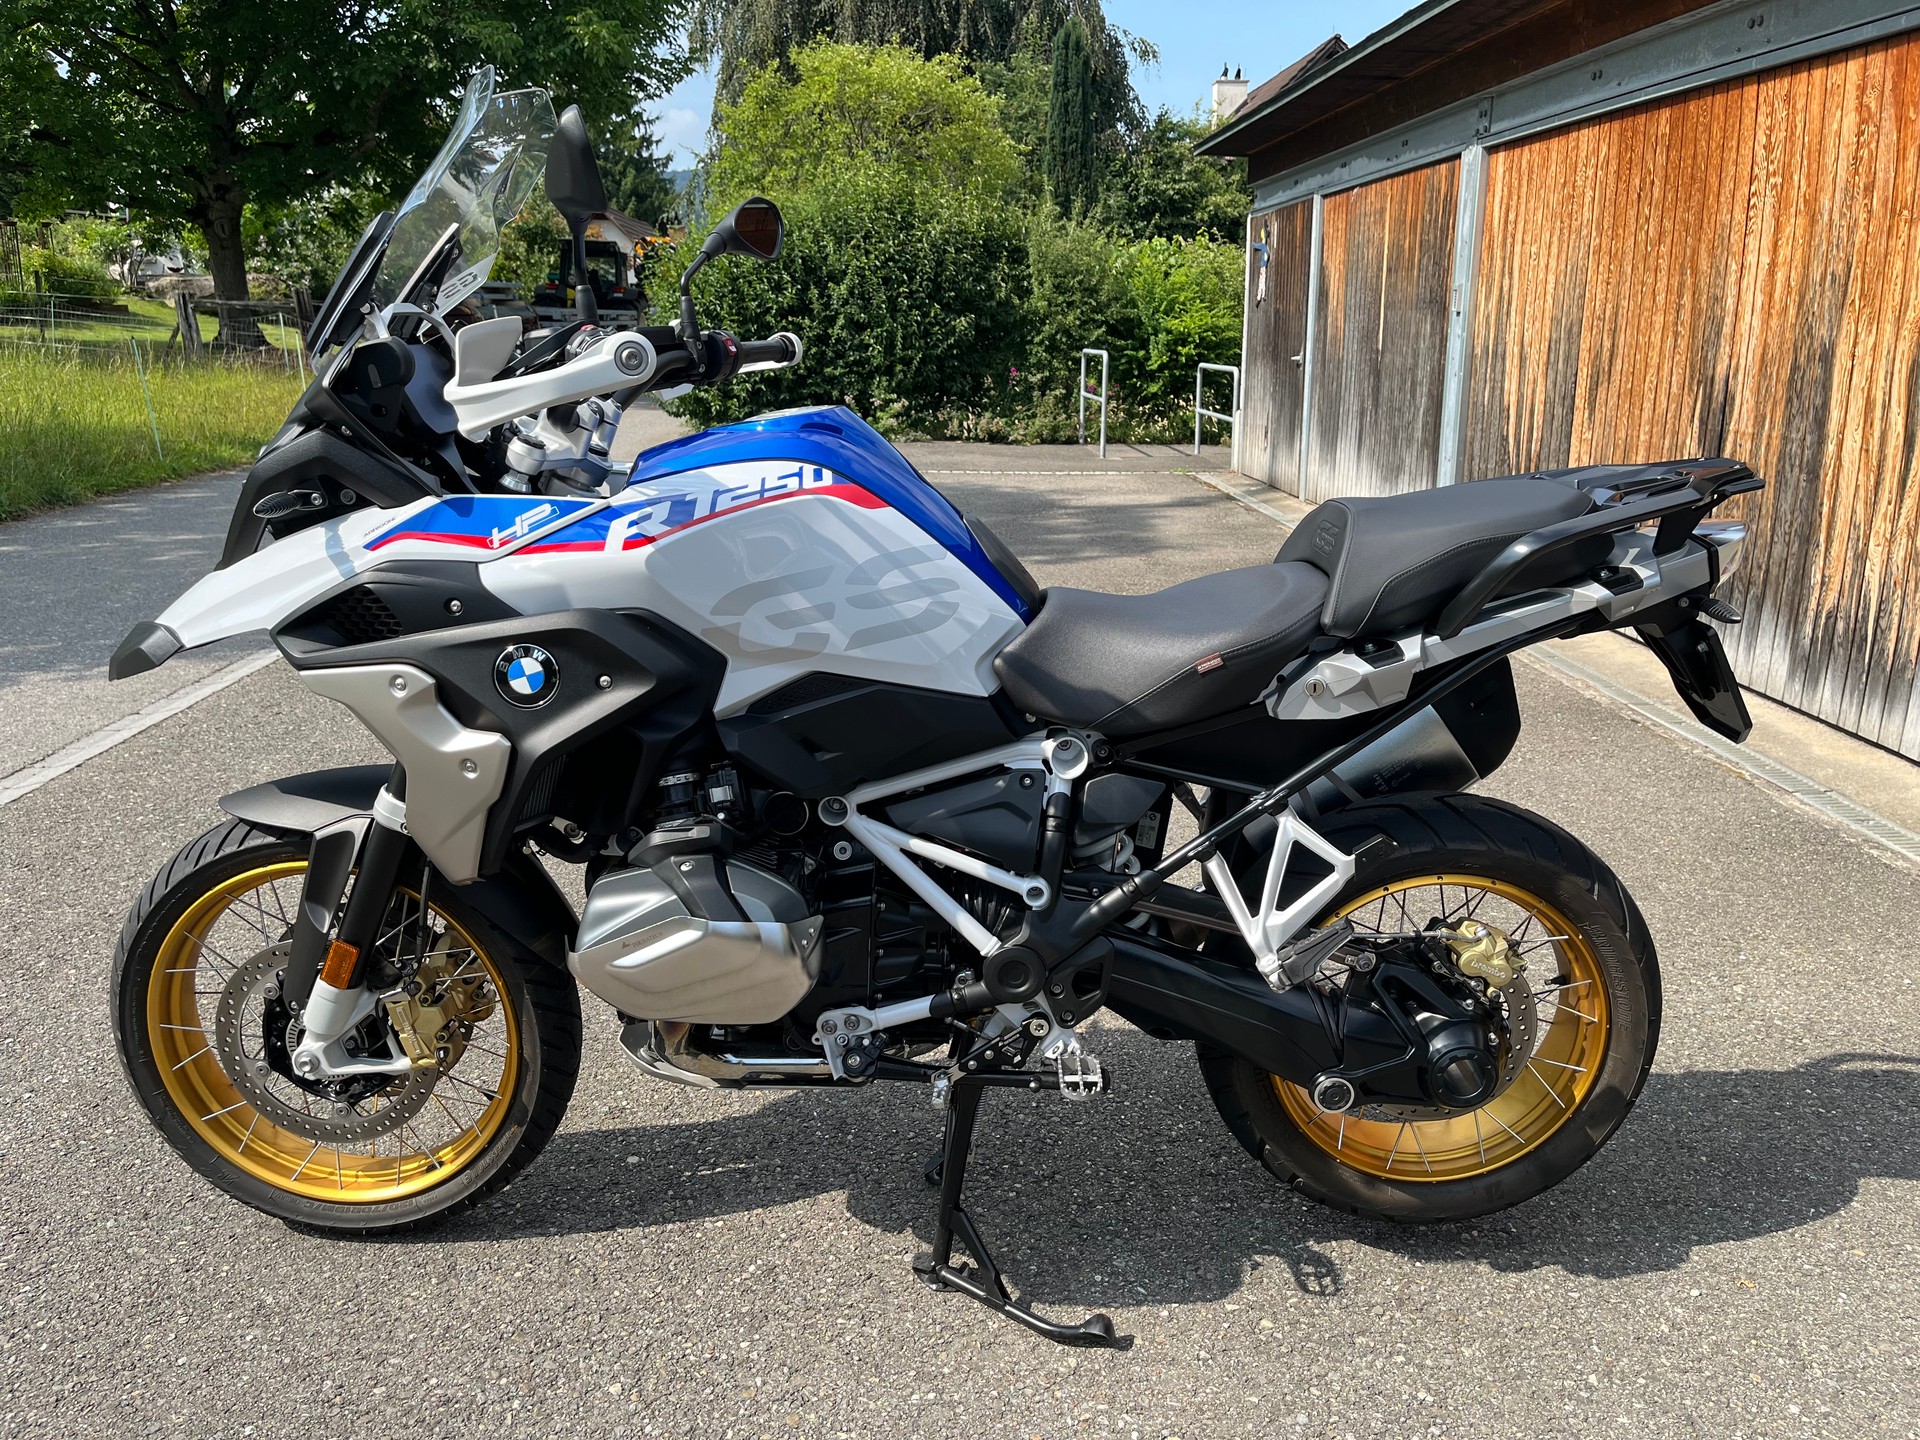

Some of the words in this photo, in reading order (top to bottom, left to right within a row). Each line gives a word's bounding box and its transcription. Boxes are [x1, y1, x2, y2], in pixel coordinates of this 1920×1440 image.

[490, 503, 553, 549] HP
[700, 543, 961, 674] GS
[498, 647, 547, 673] BMW
[1470, 958, 1507, 979] brembo
[1591, 924, 1633, 1033] BRIDGESTONE
